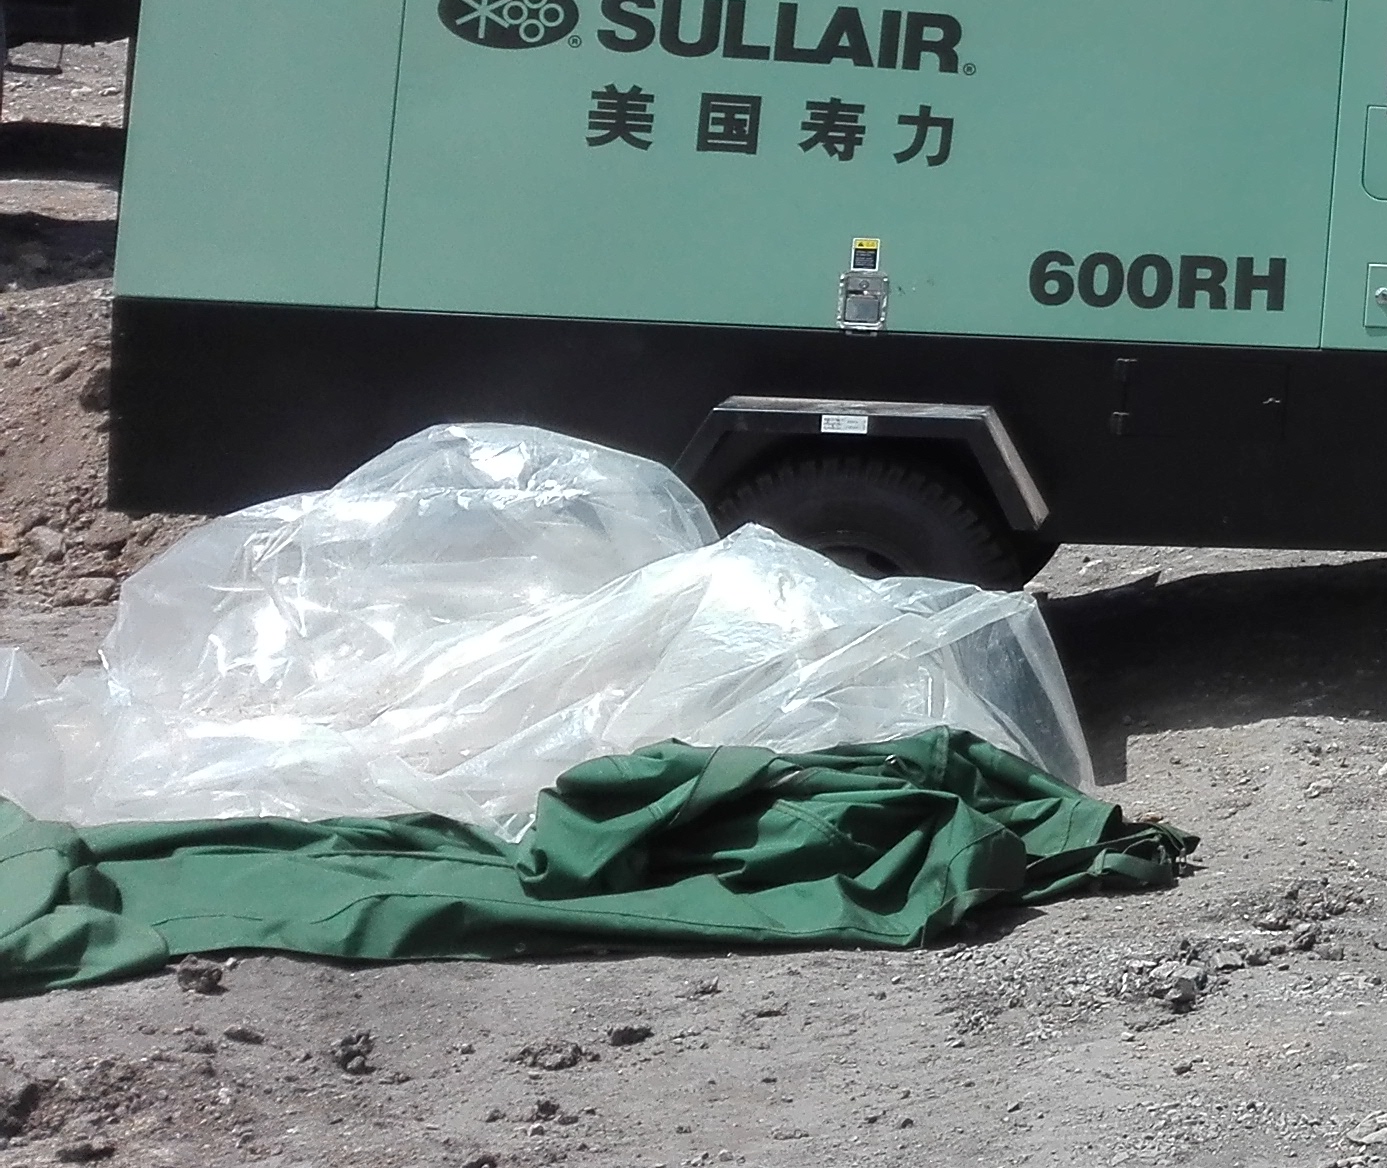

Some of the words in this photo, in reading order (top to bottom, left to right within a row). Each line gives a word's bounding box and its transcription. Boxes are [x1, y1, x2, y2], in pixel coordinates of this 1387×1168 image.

[586, 83, 954, 167] 美国寿力
[1029, 250, 1287, 311] 600RH
